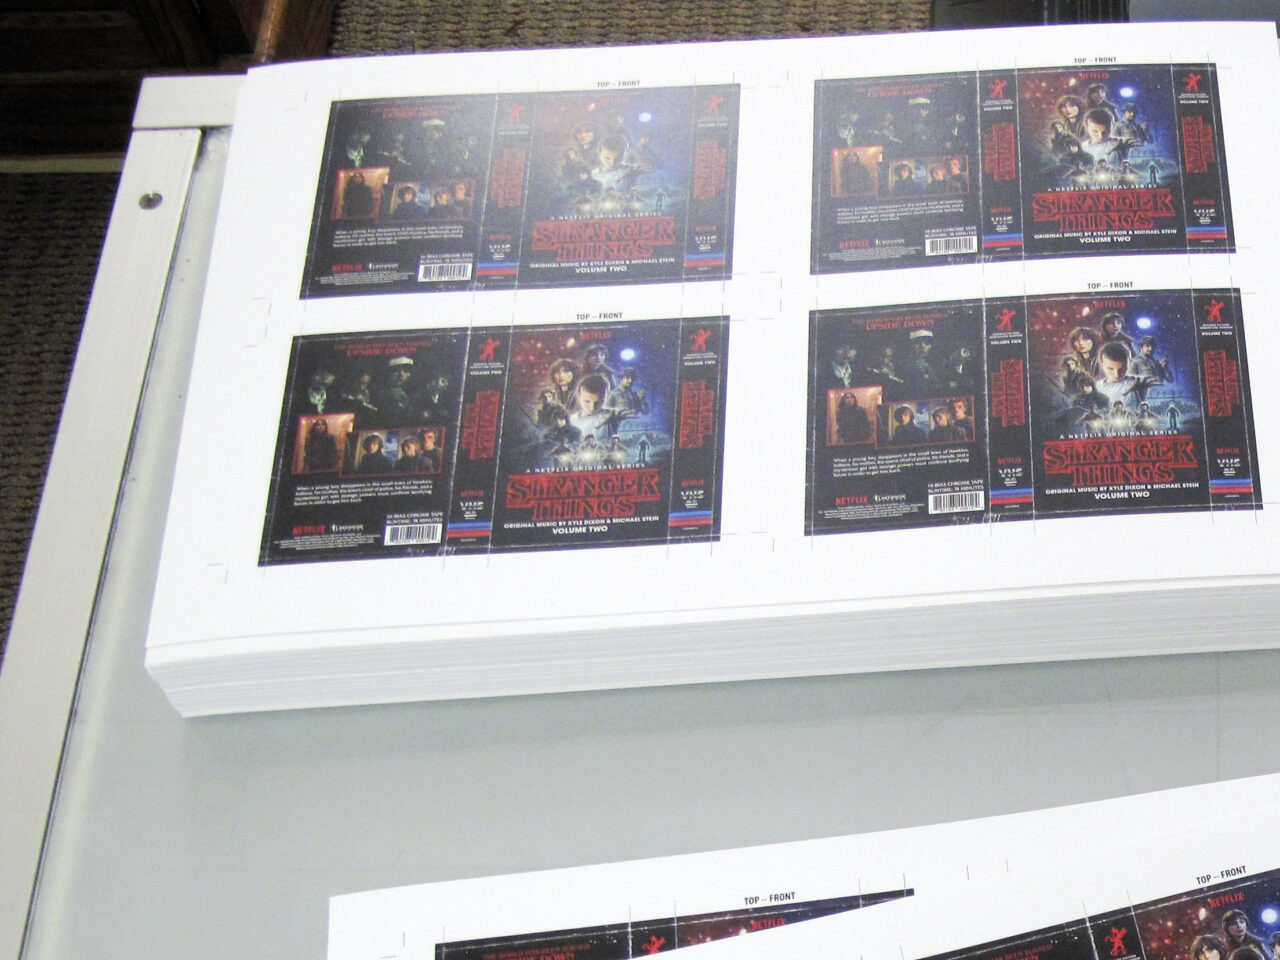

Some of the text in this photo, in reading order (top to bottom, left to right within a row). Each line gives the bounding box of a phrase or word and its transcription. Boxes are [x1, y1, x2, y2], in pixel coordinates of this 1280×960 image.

[1031, 188, 1176, 221] STRANGER
[1055, 210, 1154, 232] THINGS
[530, 216, 678, 249] STRANGER
[552, 239, 654, 261] THINGS
[597, 311, 624, 319] FRONT
[1042, 435, 1198, 473] STRANGER
[1068, 461, 1175, 486] THINGS
[504, 468, 662, 507] STRANGER
[1093, 491, 1129, 499] VOLUME
[528, 495, 636, 520] THINGS
[551, 524, 608, 534] VOLUME TWO
[1195, 864, 1248, 885] TOP FRONT
[744, 892, 797, 906] TOP FRONT
[1208, 891, 1244, 908] NETFLIX
